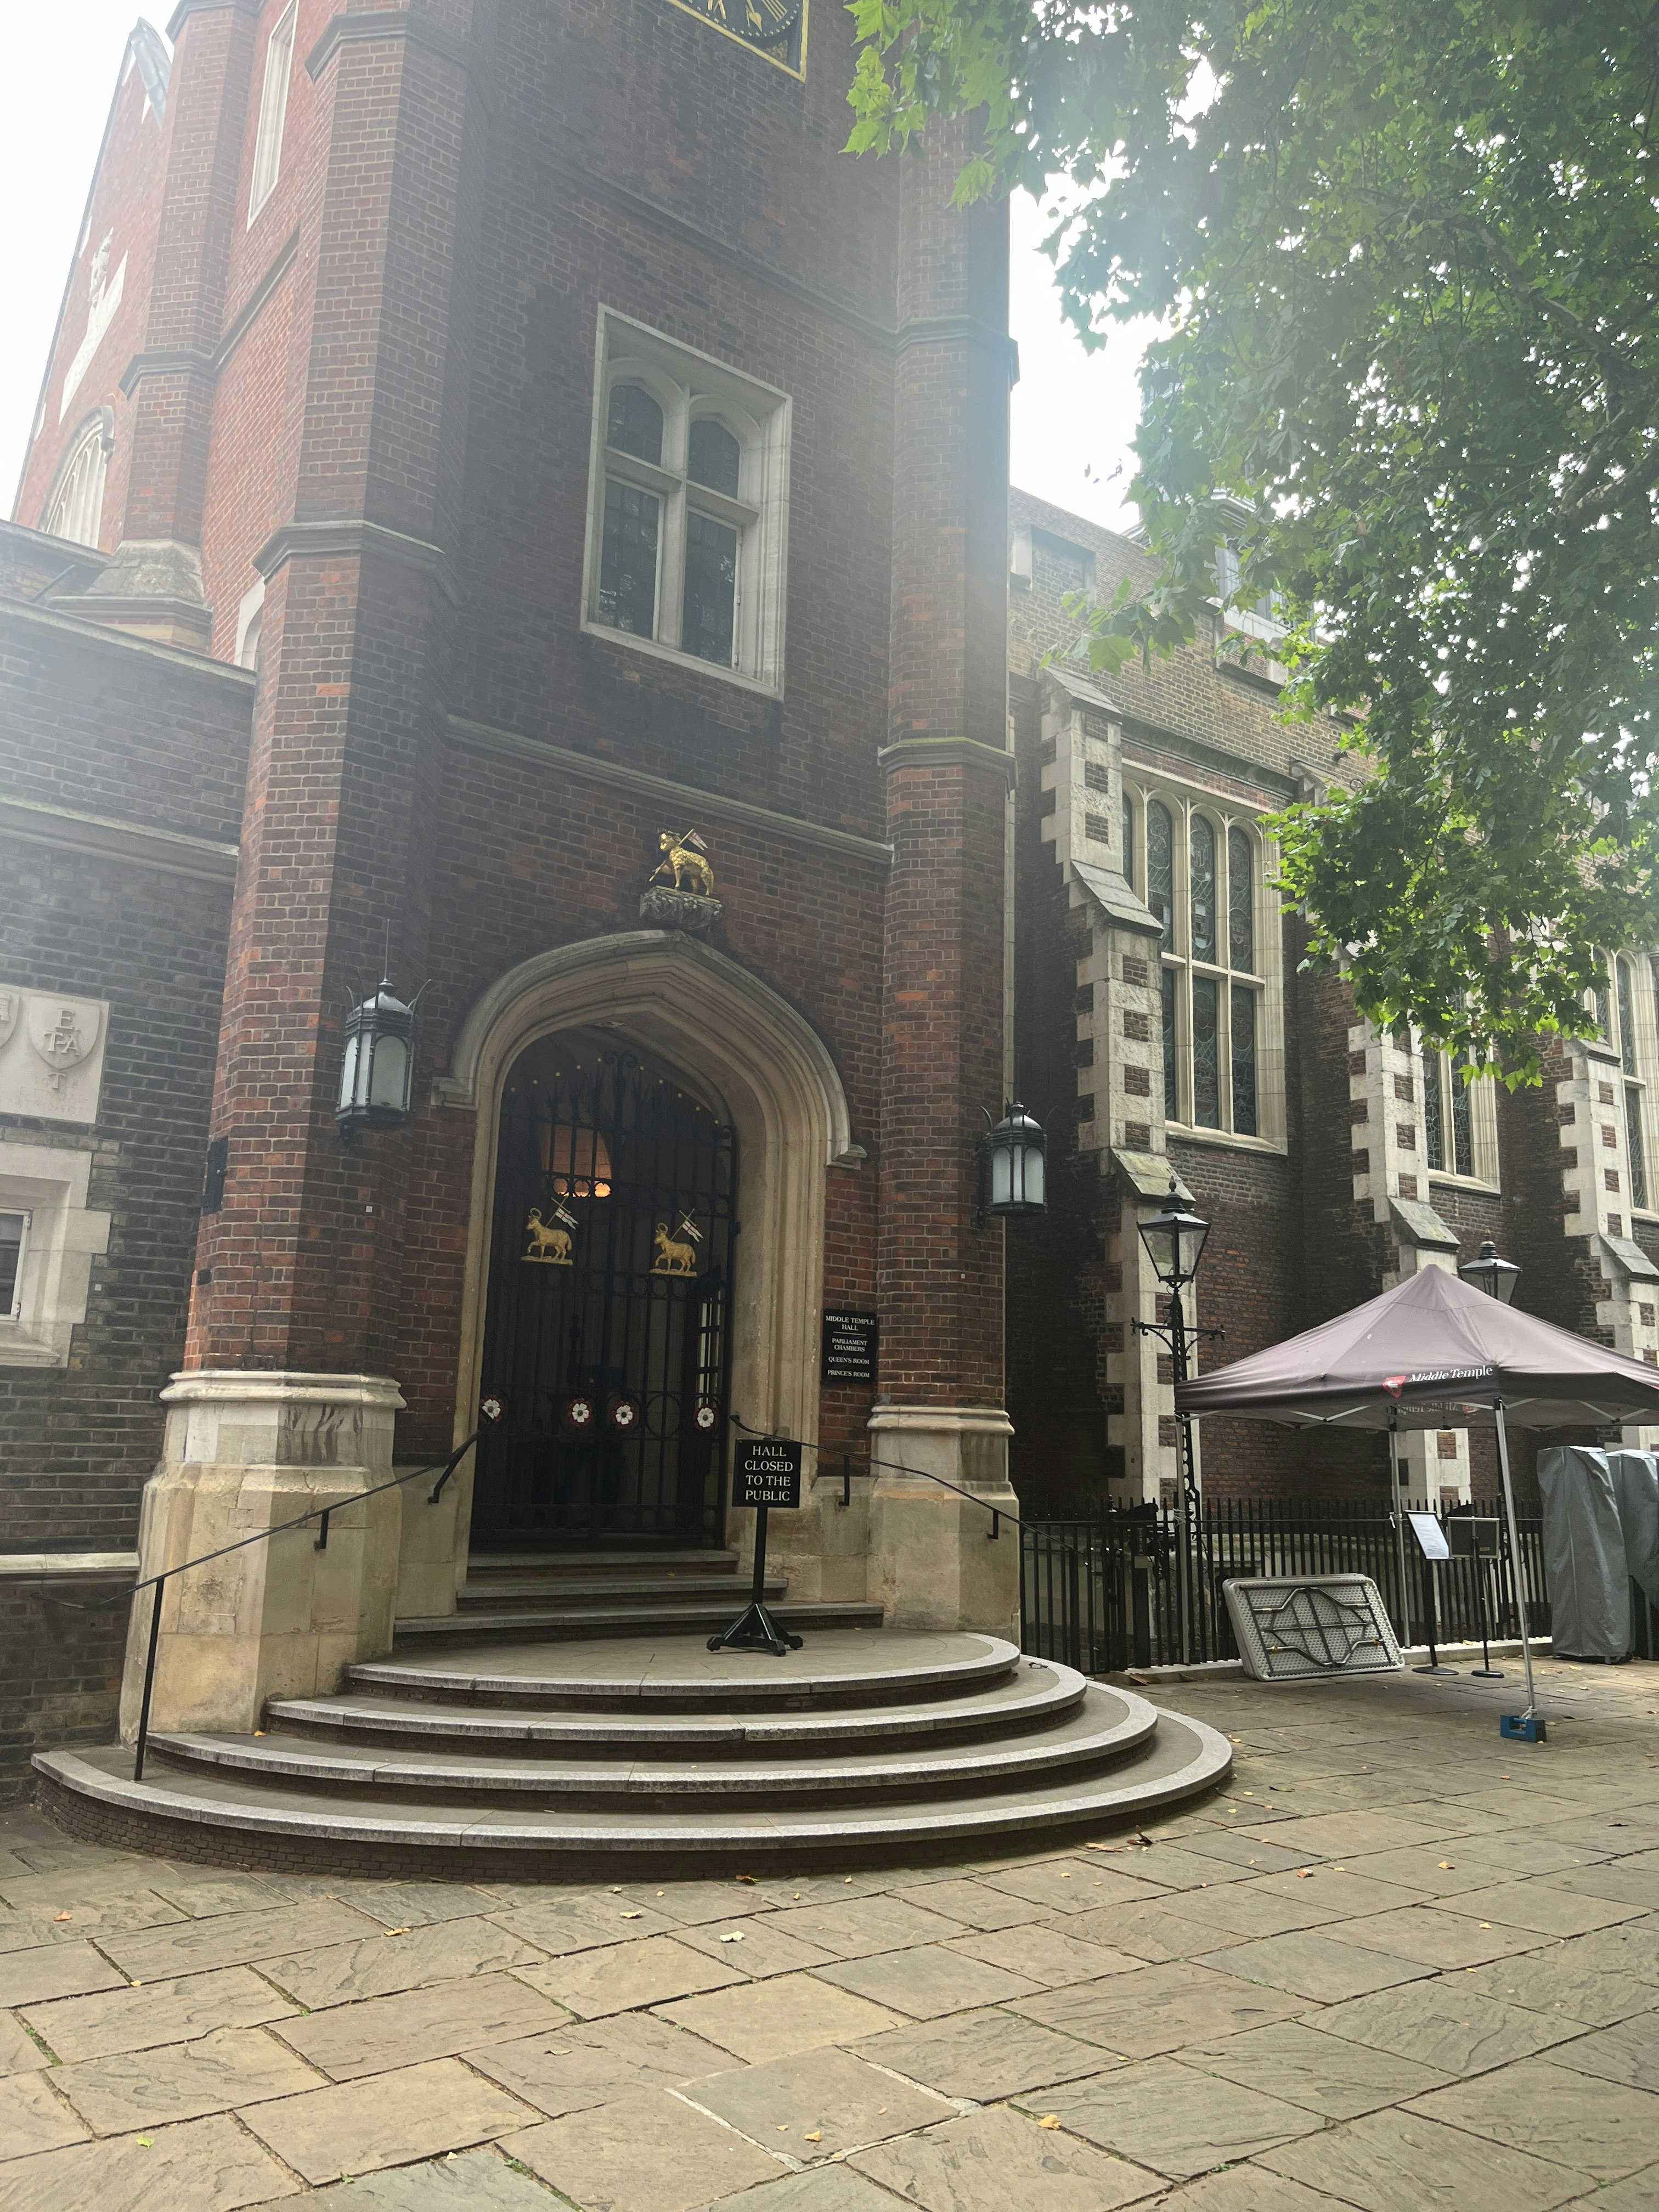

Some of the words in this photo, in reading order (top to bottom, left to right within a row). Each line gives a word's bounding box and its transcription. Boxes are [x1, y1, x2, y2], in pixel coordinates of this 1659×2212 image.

[832, 1338, 868, 1346] PARLIAMENT
[1409, 1370, 1449, 1383] Middle
[1450, 1365, 1493, 1379] Temple
[752, 1445, 787, 1457] HALL
[744, 1460, 793, 1471] CLOSED
[746, 1475, 763, 1486] TO
[765, 1476, 791, 1486] THE
[745, 1489, 790, 1502] PUBLIC
